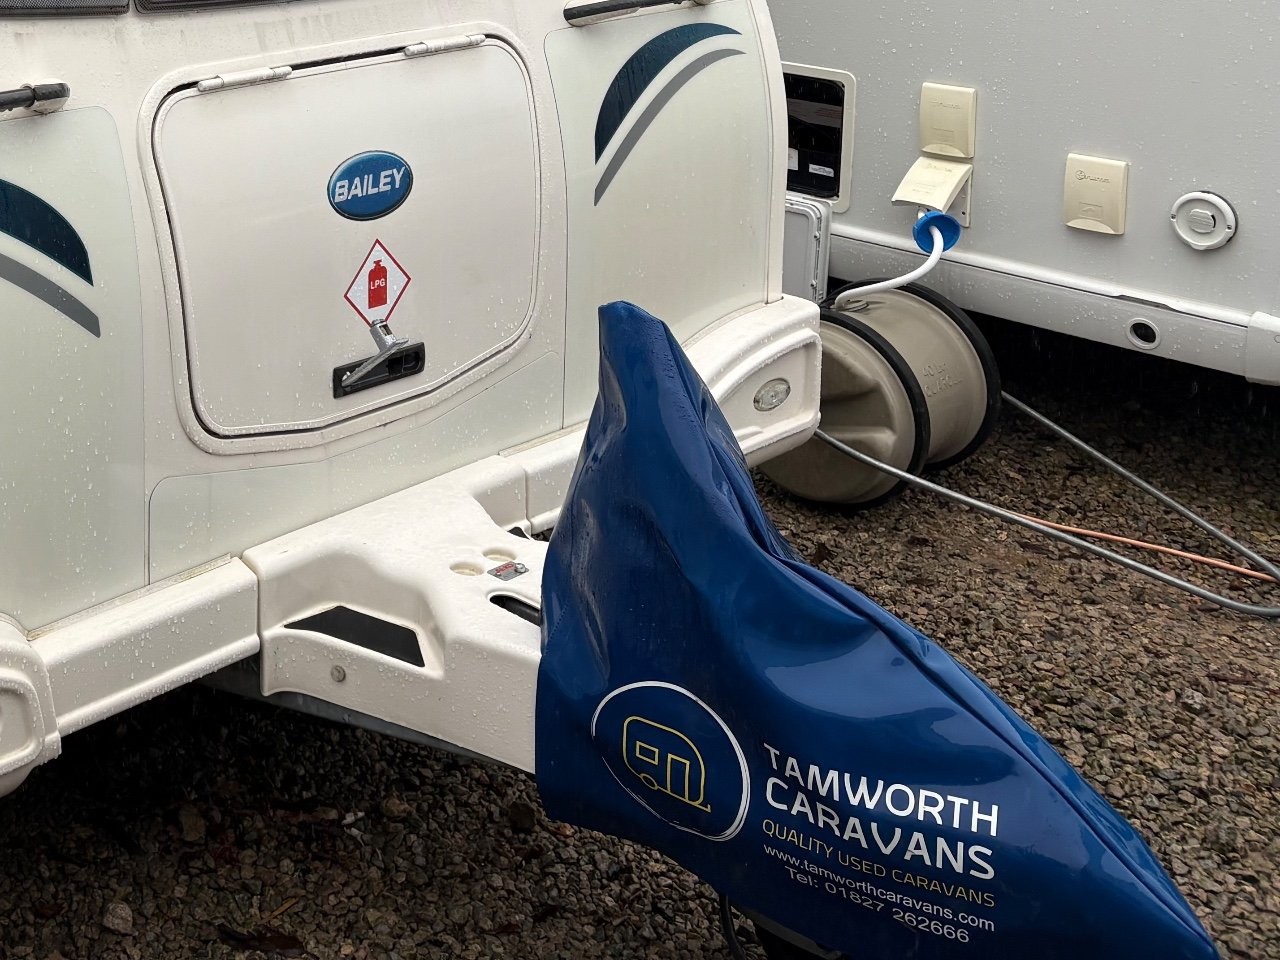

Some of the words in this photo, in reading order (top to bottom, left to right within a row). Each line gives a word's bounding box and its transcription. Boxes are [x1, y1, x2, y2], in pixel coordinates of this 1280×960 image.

[334, 166, 406, 203] BAILEY
[370, 278, 385, 289] LPG
[764, 743, 998, 837] TAMWORTH
[765, 777, 995, 880] CARAVANS
[762, 819, 834, 858] QUALITY
[838, 851, 886, 877] USED
[892, 869, 995, 907] CARAVANS
[763, 844, 995, 932] www.tamworthcaravans.com
[785, 865, 819, 888] Tel:
[825, 882, 885, 912] 01827
[892, 908, 970, 943] 262666
